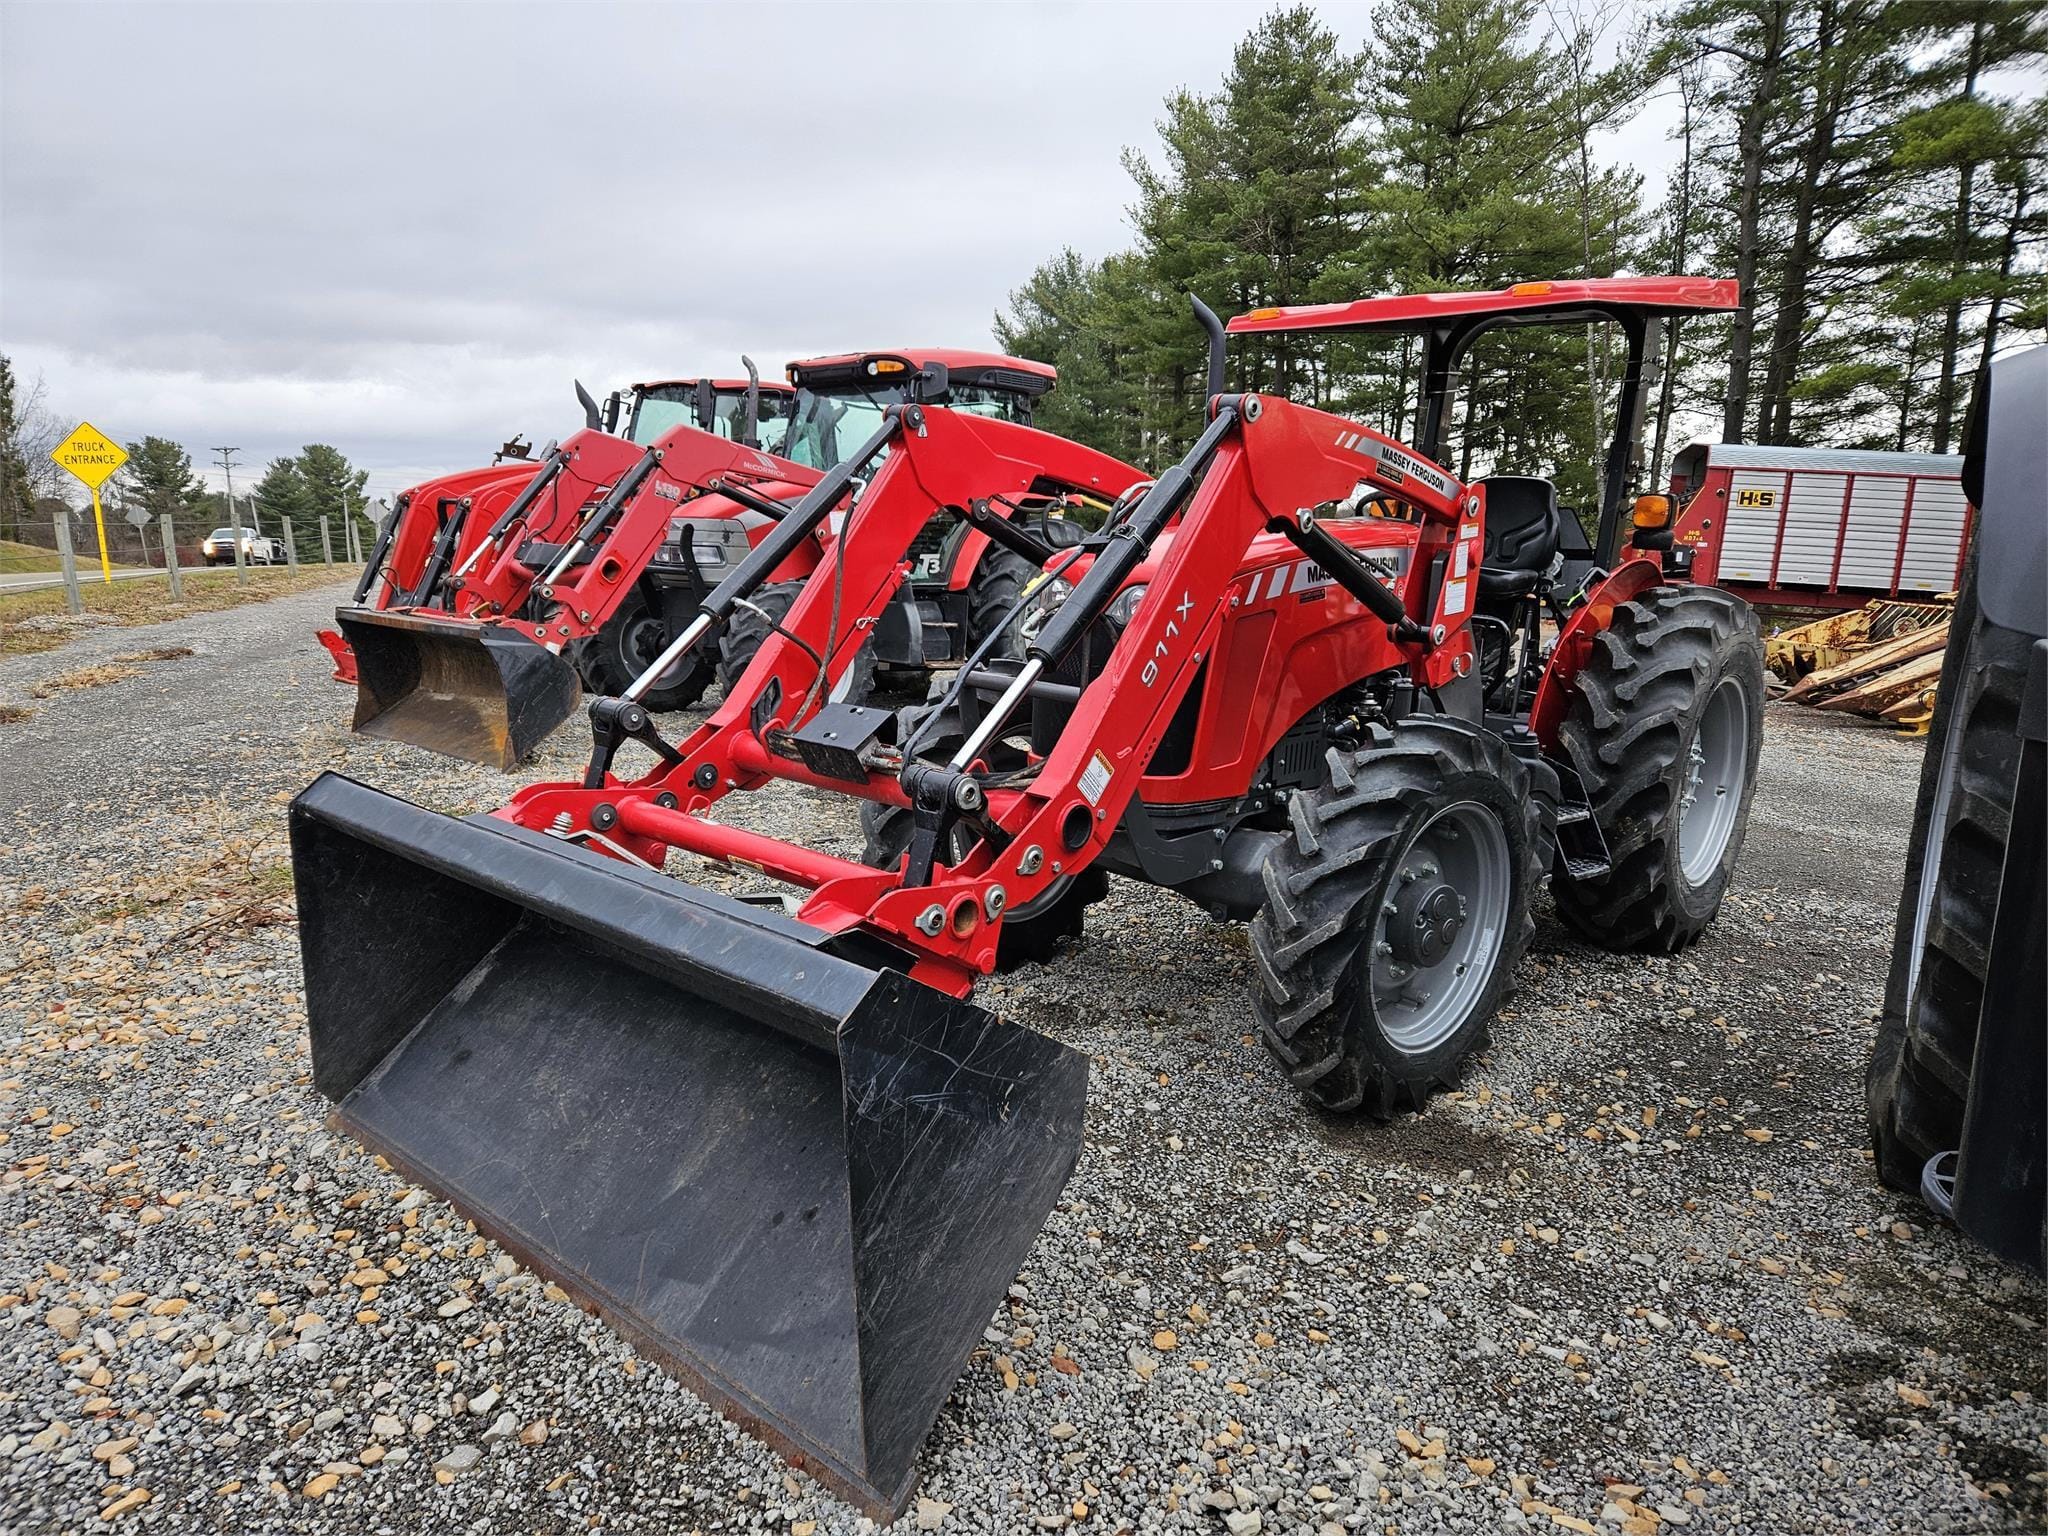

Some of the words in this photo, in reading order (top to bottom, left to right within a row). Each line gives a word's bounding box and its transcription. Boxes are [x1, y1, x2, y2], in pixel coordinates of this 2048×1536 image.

[72, 442, 105, 451] TRUCK
[64, 455, 116, 464] ENTRANCE
[743, 461, 786, 479] McCORMICK
[1381, 447, 1411, 470] MASSEY
[1410, 461, 1446, 491] FERGUSON
[1739, 491, 1774, 506] H&S
[1141, 590, 1195, 688] 911X
